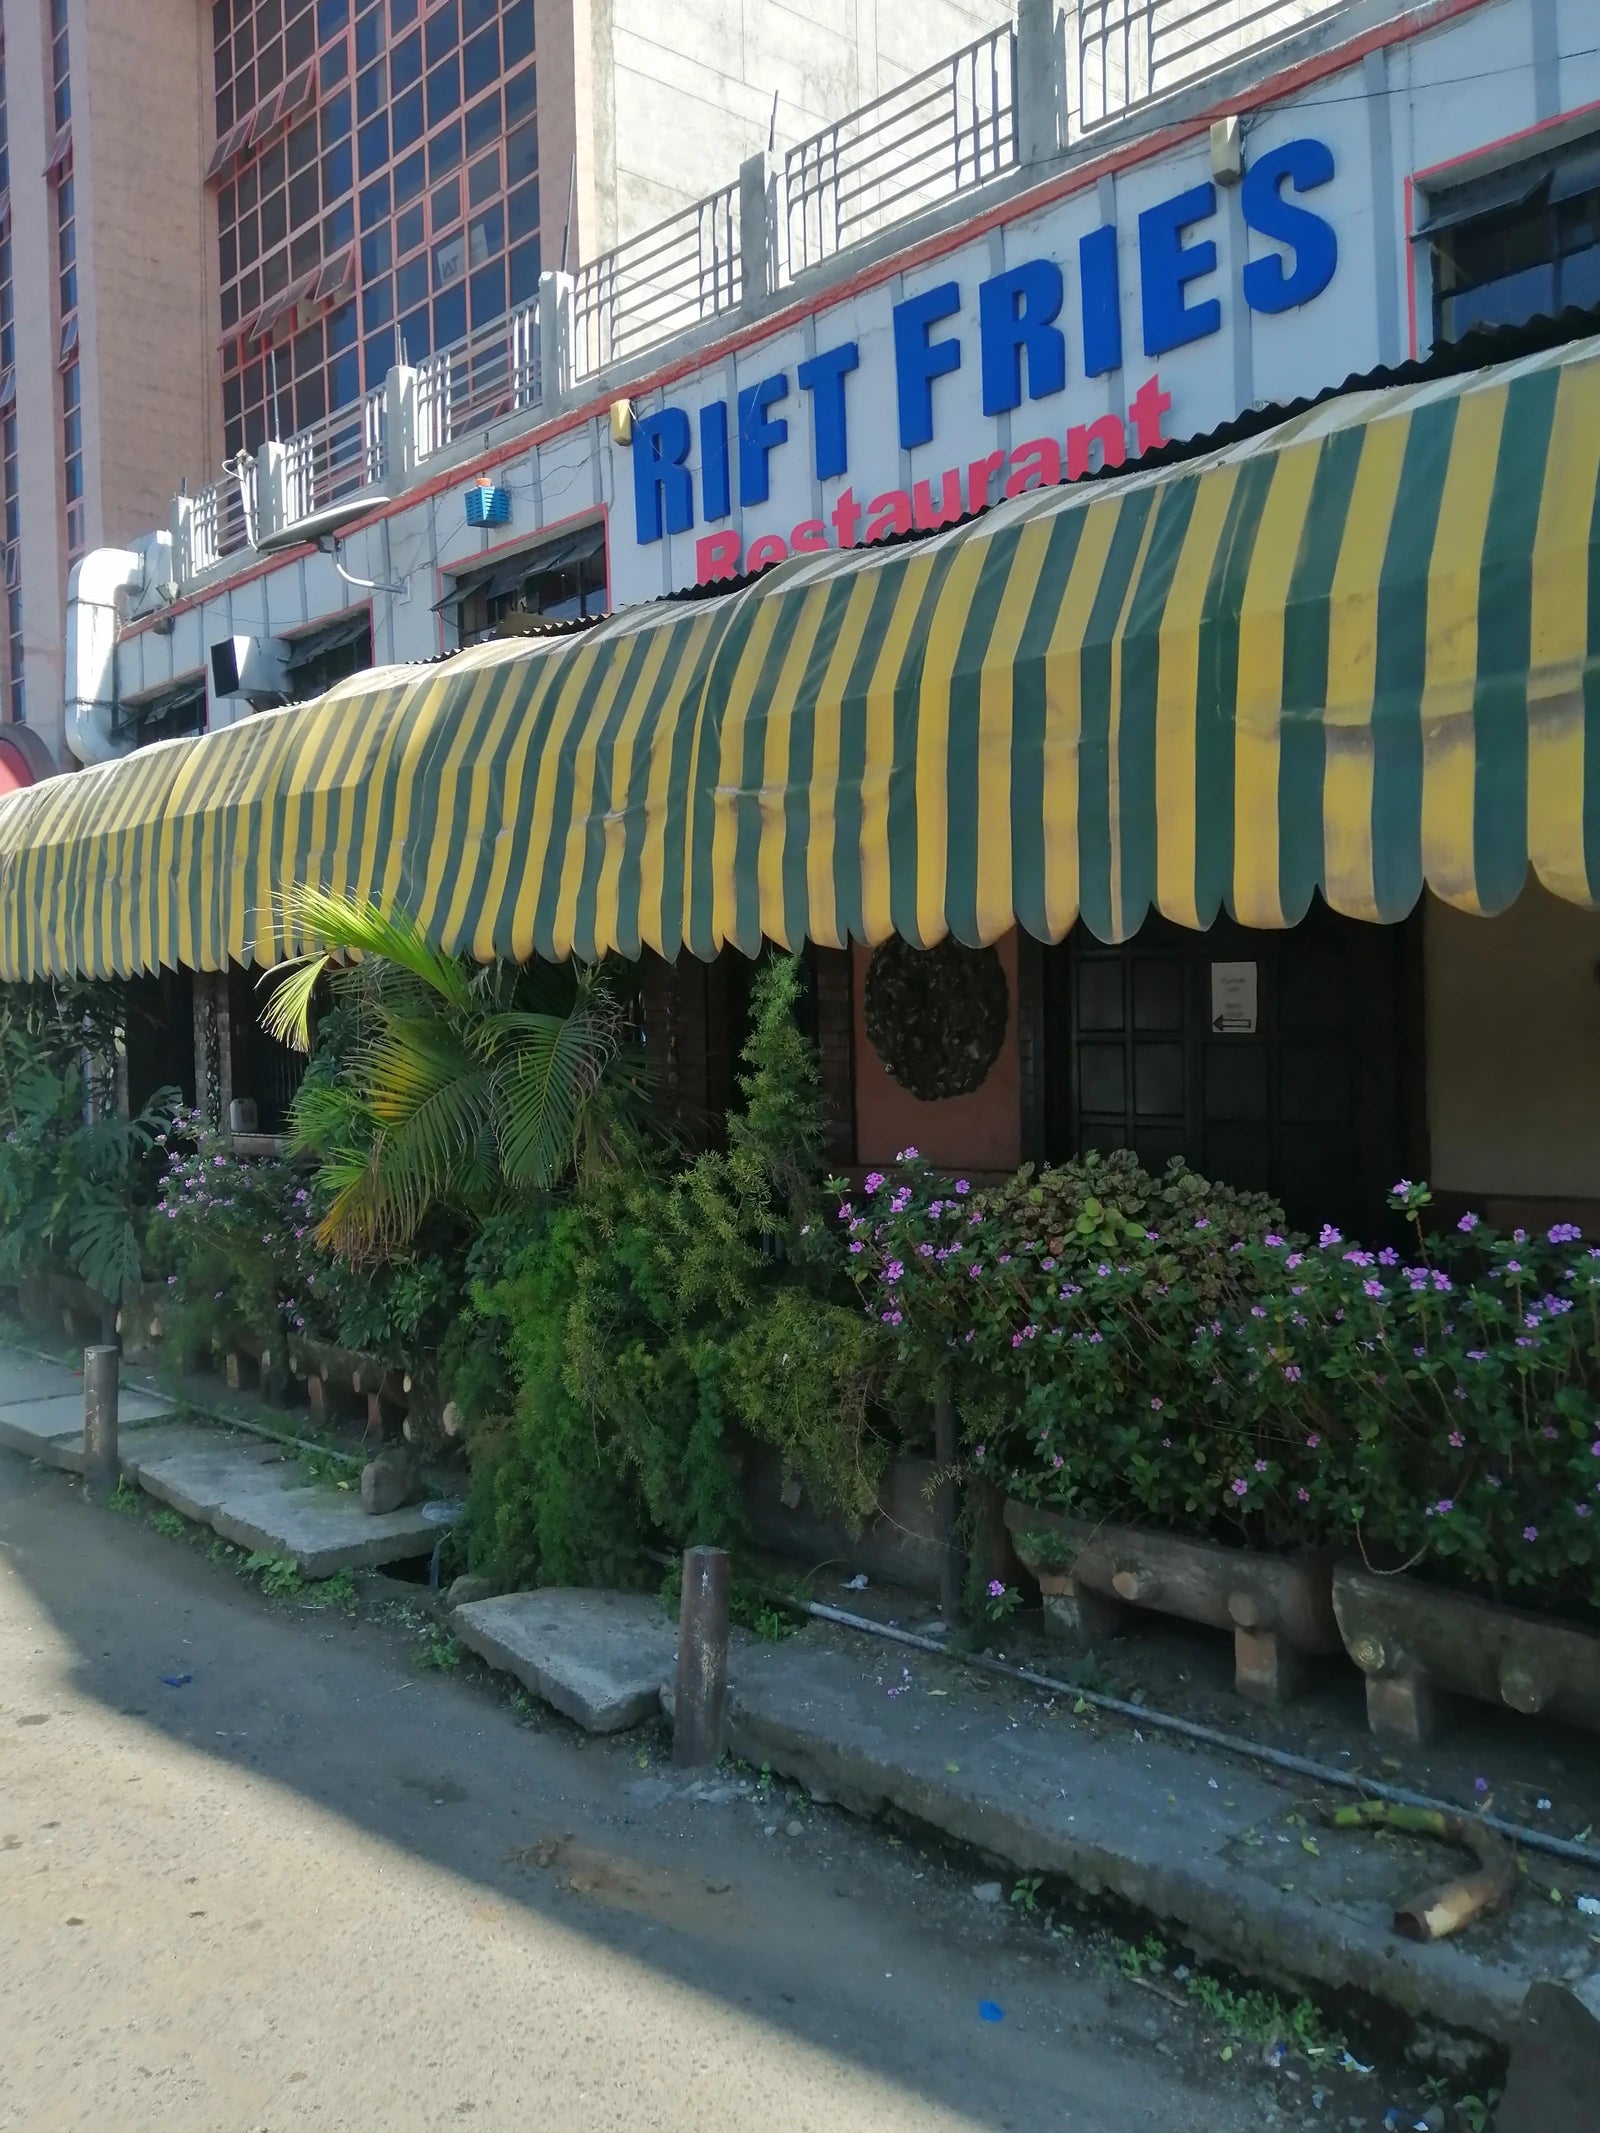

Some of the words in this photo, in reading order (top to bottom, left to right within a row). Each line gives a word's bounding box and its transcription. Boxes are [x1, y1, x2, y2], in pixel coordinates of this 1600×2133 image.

[633, 342, 858, 545] RIFT
[894, 139, 1338, 450] FRIES
[696, 373, 1171, 585] Restaurant
